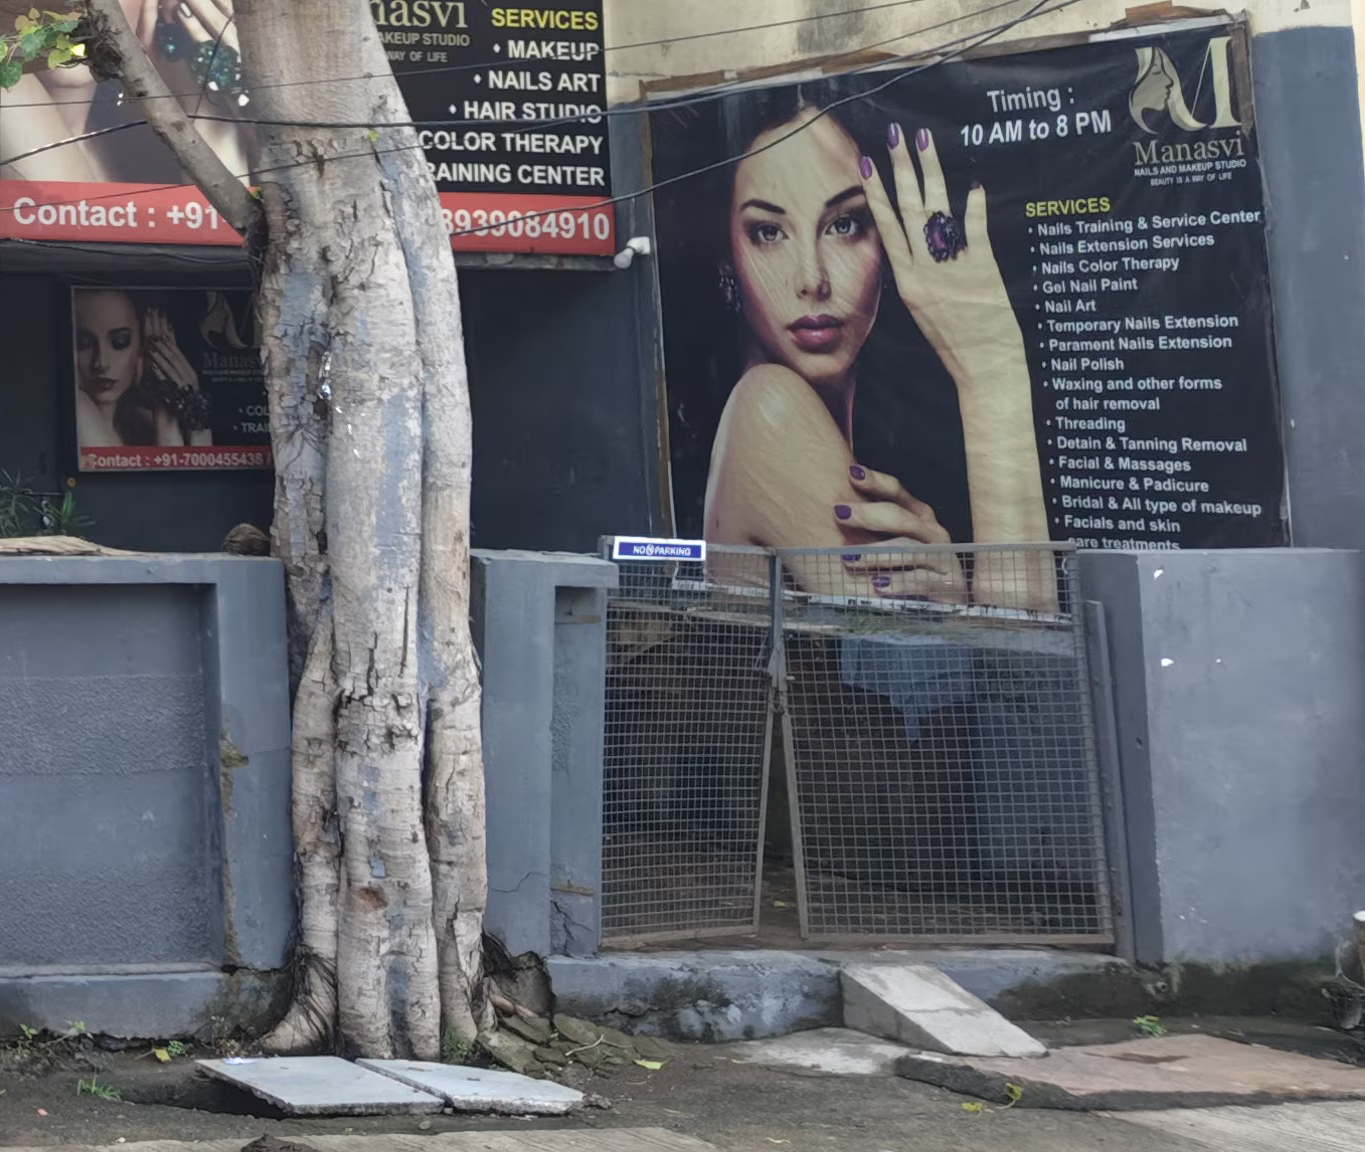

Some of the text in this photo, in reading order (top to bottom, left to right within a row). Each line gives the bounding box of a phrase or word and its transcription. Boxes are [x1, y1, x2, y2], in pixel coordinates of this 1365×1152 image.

[491, 8, 599, 30] SERVICES
[422, 34, 470, 46] STUDIO
[507, 40, 600, 61] MAKEUP
[488, 70, 601, 92] NAILS ART
[987, 86, 1061, 113] Timing
[464, 101, 602, 124] HAIR STUDIO
[961, 110, 1112, 147] 10 AM to 8 PM
[420, 130, 603, 155] COLOR THERAPY
[1133, 130, 1245, 166] Manasvi
[427, 163, 605, 186] RAINING CENTER
[1134, 166, 1159, 177] NAILS
[1178, 162, 1214, 173] MAKEUP
[1215, 158, 1247, 170] STUDIO
[13, 197, 137, 228] Contact
[1025, 197, 1111, 218] SERVICES
[1037, 210, 1261, 237] Nails Training Service Center
[1040, 233, 1215, 256] Nails Extension Services
[1041, 256, 1180, 275] Nails Color Therapy
[1042, 278, 1138, 294] Gel Nail Paint
[1045, 300, 1097, 314] Nail Art
[1047, 314, 1239, 334] Temporary Nails Extension
[1049, 335, 1233, 353] Parament Nails Extension
[1051, 358, 1124, 372] Nail Polish
[1052, 375, 1223, 393] Waxing and other forms
[1056, 397, 1160, 410] of hair removal
[1055, 416, 1126, 433] Threading
[1057, 436, 1247, 454] Detain Tanning Removal
[1058, 456, 1192, 474] Facial Massages
[1060, 475, 1209, 493] Manicure Padicure
[1062, 495, 1262, 517] Bridal All type of makeup
[1064, 514, 1181, 533] Facials and skin
